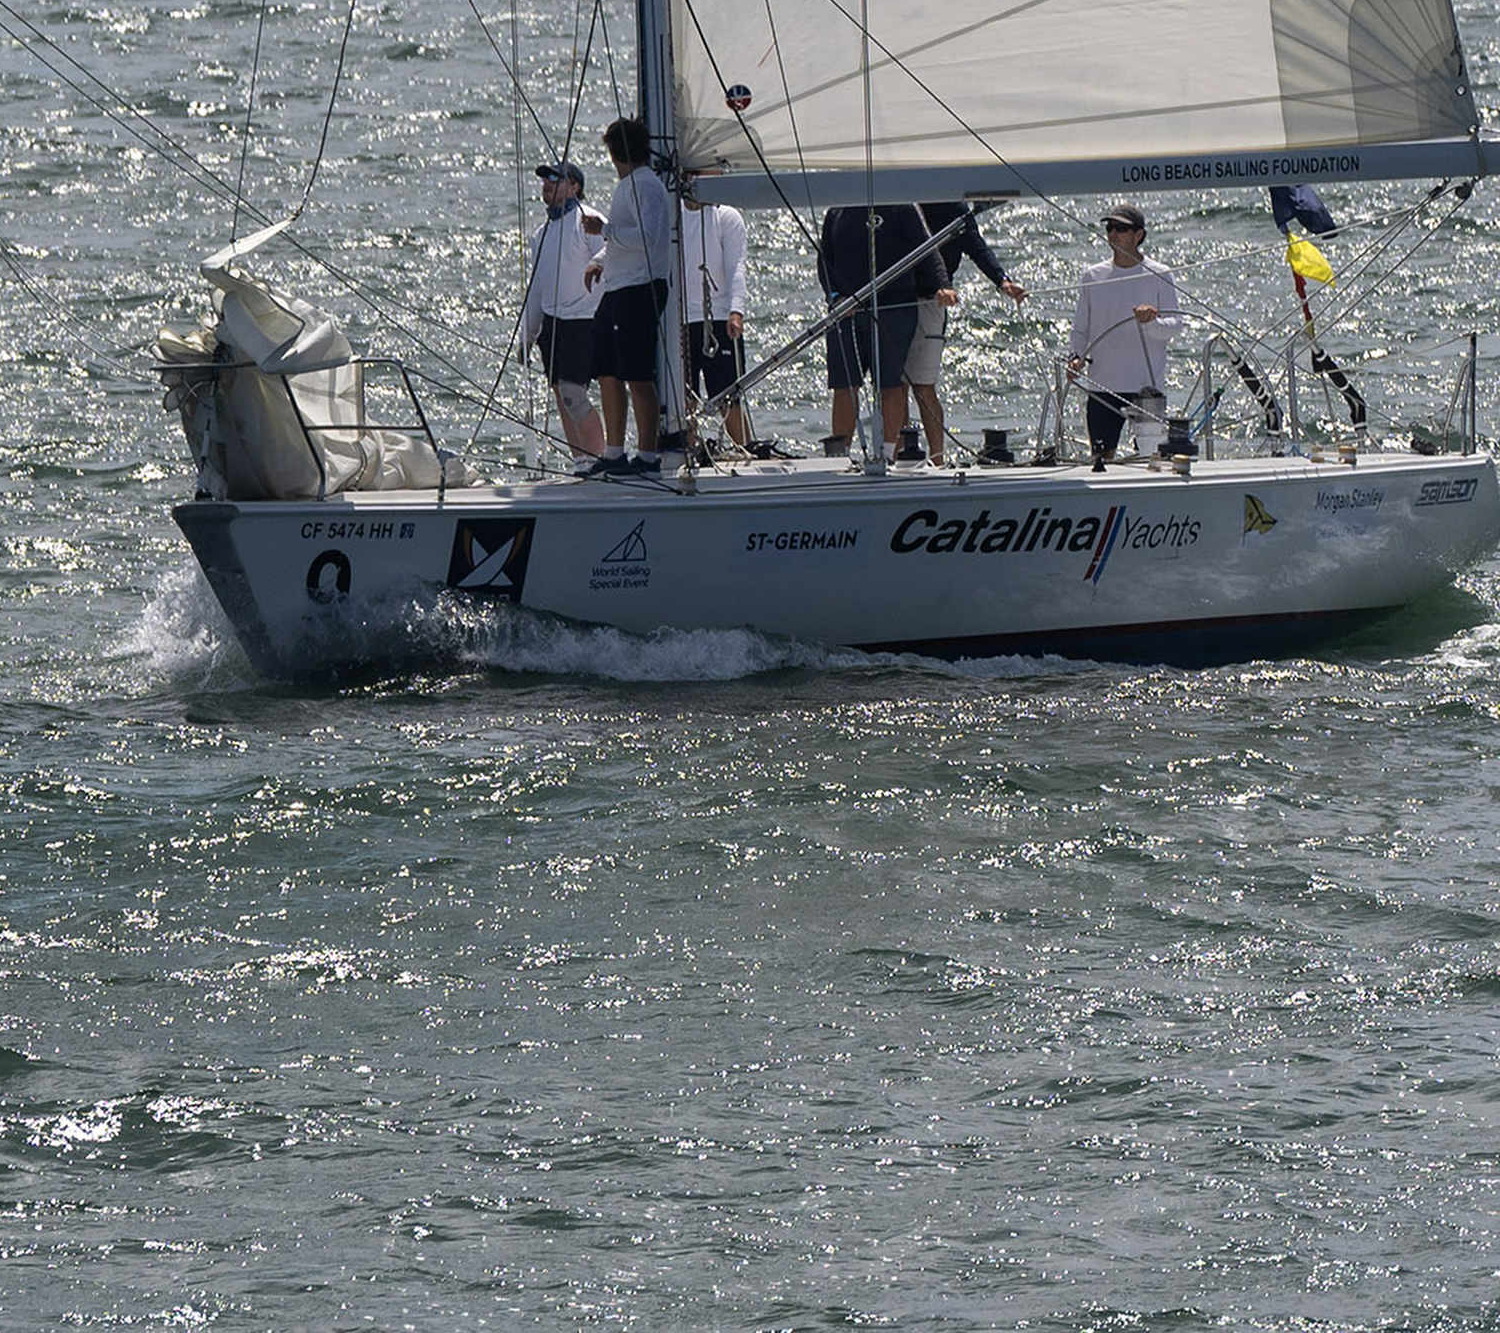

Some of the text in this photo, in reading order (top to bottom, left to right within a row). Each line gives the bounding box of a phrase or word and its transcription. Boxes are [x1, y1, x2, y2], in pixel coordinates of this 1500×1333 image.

[1122, 155, 1360, 183] LONG BEACH SAILING FOUNDATION
[1315, 488, 1385, 514] Morgan Stanley
[301, 521, 324, 539] CF
[327, 521, 365, 539] 5474
[368, 521, 394, 539] HH
[889, 507, 1202, 555] Catalina Yachts
